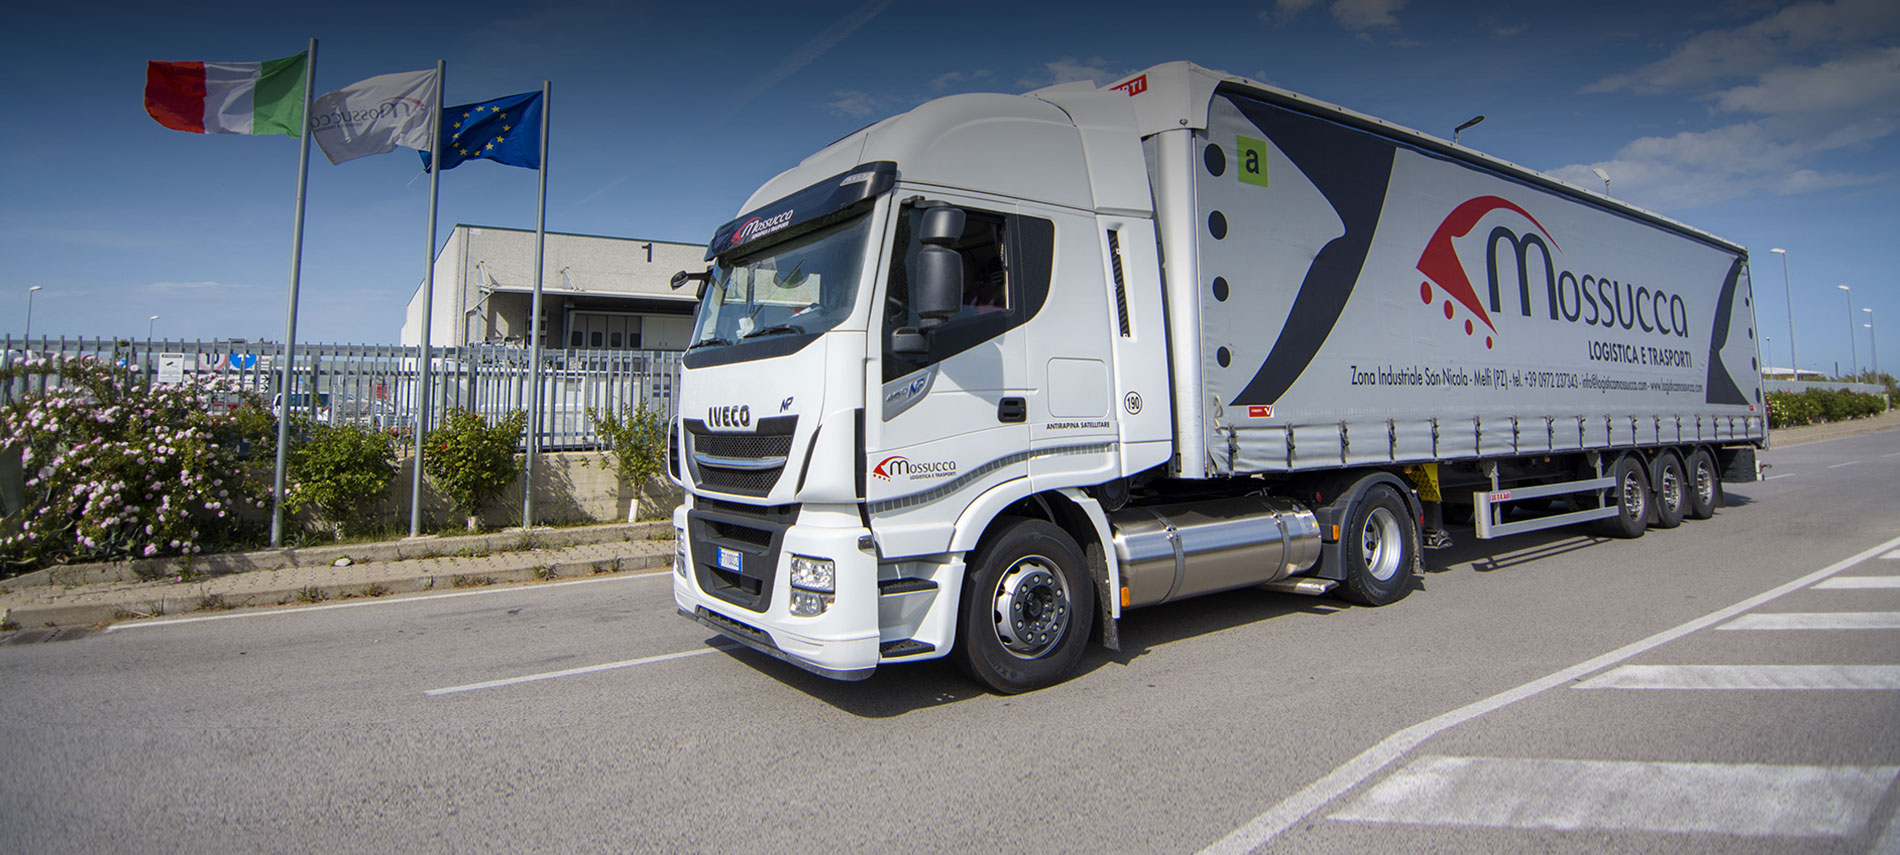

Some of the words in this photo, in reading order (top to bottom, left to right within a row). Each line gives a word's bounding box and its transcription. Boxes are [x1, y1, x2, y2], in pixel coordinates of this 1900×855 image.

[1245, 148, 1260, 175] a
[740, 209, 794, 239] Mossucca
[641, 242, 652, 263] 1
[1485, 225, 1689, 339] Mossucca
[1588, 340, 1639, 364] LOGISTICA
[1641, 347, 1647, 365] E
[1648, 348, 1693, 369] TRASPORTI
[1351, 365, 1376, 386] Zona
[1378, 364, 1423, 386] Industriale
[1425, 367, 1441, 386] San
[1442, 366, 1468, 386] Nicola
[1474, 367, 1492, 386] Melfi
[1493, 368, 1508, 390] (PZ)
[1512, 369, 1523, 387] tel.
[1524, 370, 1537, 387] +39
[1538, 370, 1555, 388] 0972
[1556, 371, 1578, 389] 237343
[779, 396, 794, 413] NP
[1127, 396, 1140, 410] 190
[708, 404, 751, 428] IVECO
[1046, 422, 1080, 430] ANTIRAPINA
[1080, 421, 1110, 429] SATELLITARE
[889, 459, 957, 476] Mossucca
